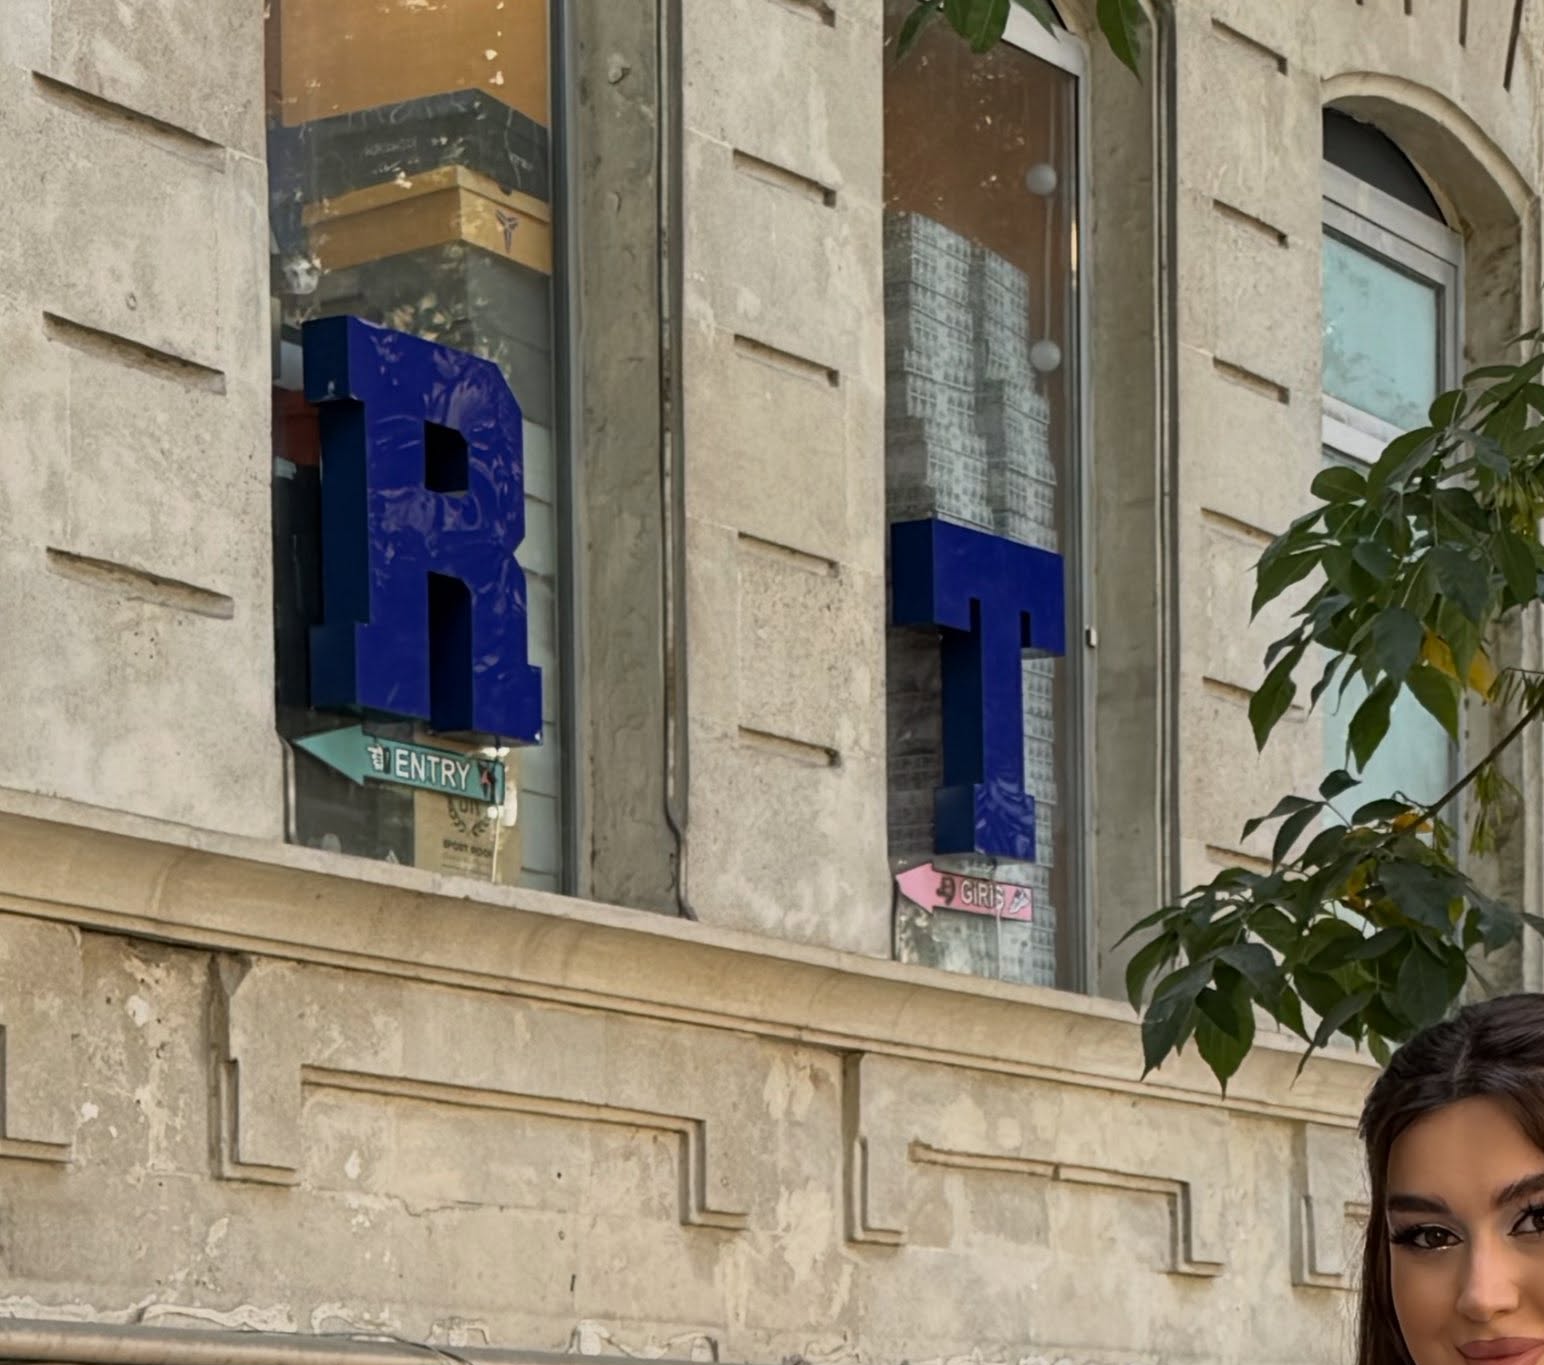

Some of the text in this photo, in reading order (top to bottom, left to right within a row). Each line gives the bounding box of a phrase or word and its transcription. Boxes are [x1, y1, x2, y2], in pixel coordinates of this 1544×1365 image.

[303, 315, 1065, 862] R T
[395, 749, 471, 791] ENTRY
